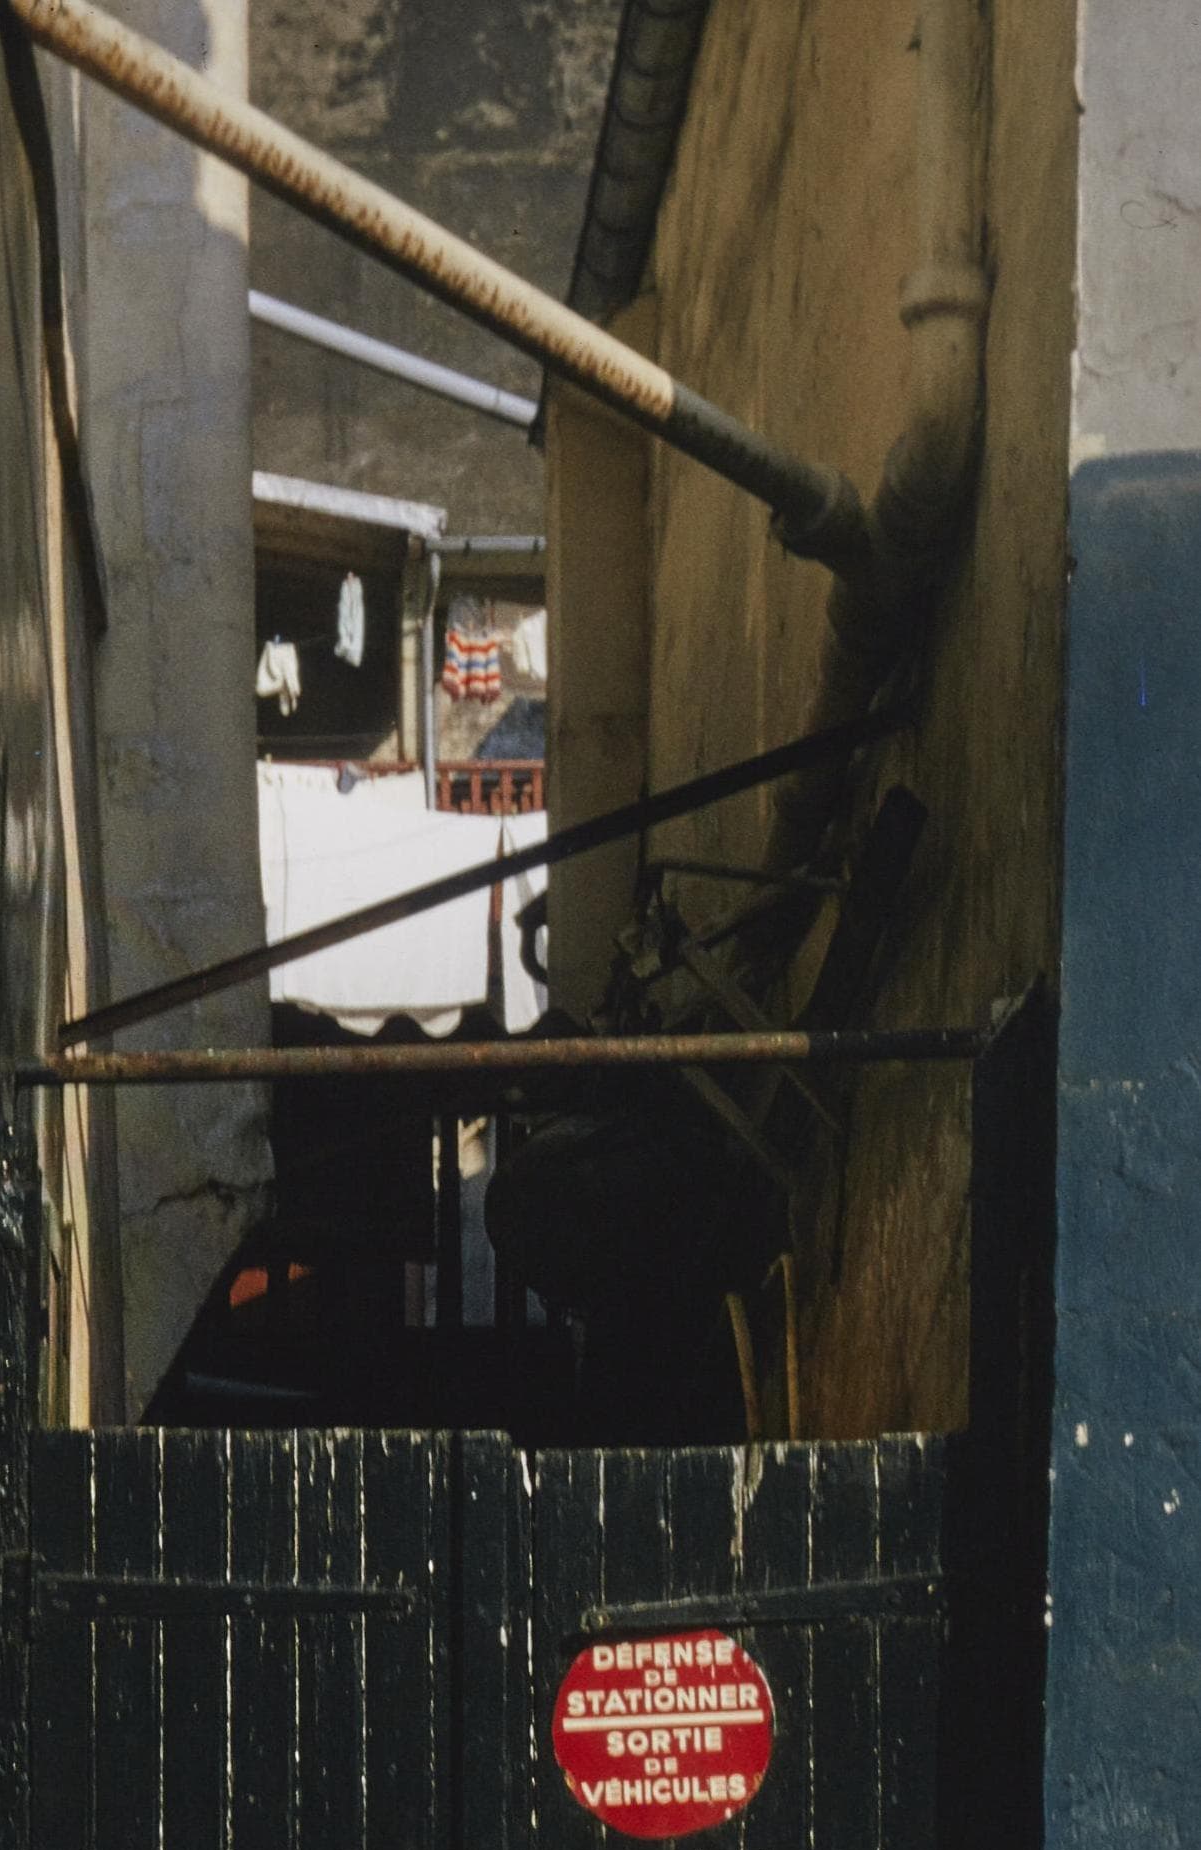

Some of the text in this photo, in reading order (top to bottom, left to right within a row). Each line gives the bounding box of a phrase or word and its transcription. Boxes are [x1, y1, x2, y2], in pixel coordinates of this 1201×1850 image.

[592, 1640, 734, 1671] DÉFENSE
[644, 1669, 678, 1686] DE
[566, 1684, 759, 1716] STATIONNER
[606, 1727, 723, 1757] SORTIE
[644, 1757, 678, 1774] DE
[581, 1774, 747, 1807] VÉHICULES
